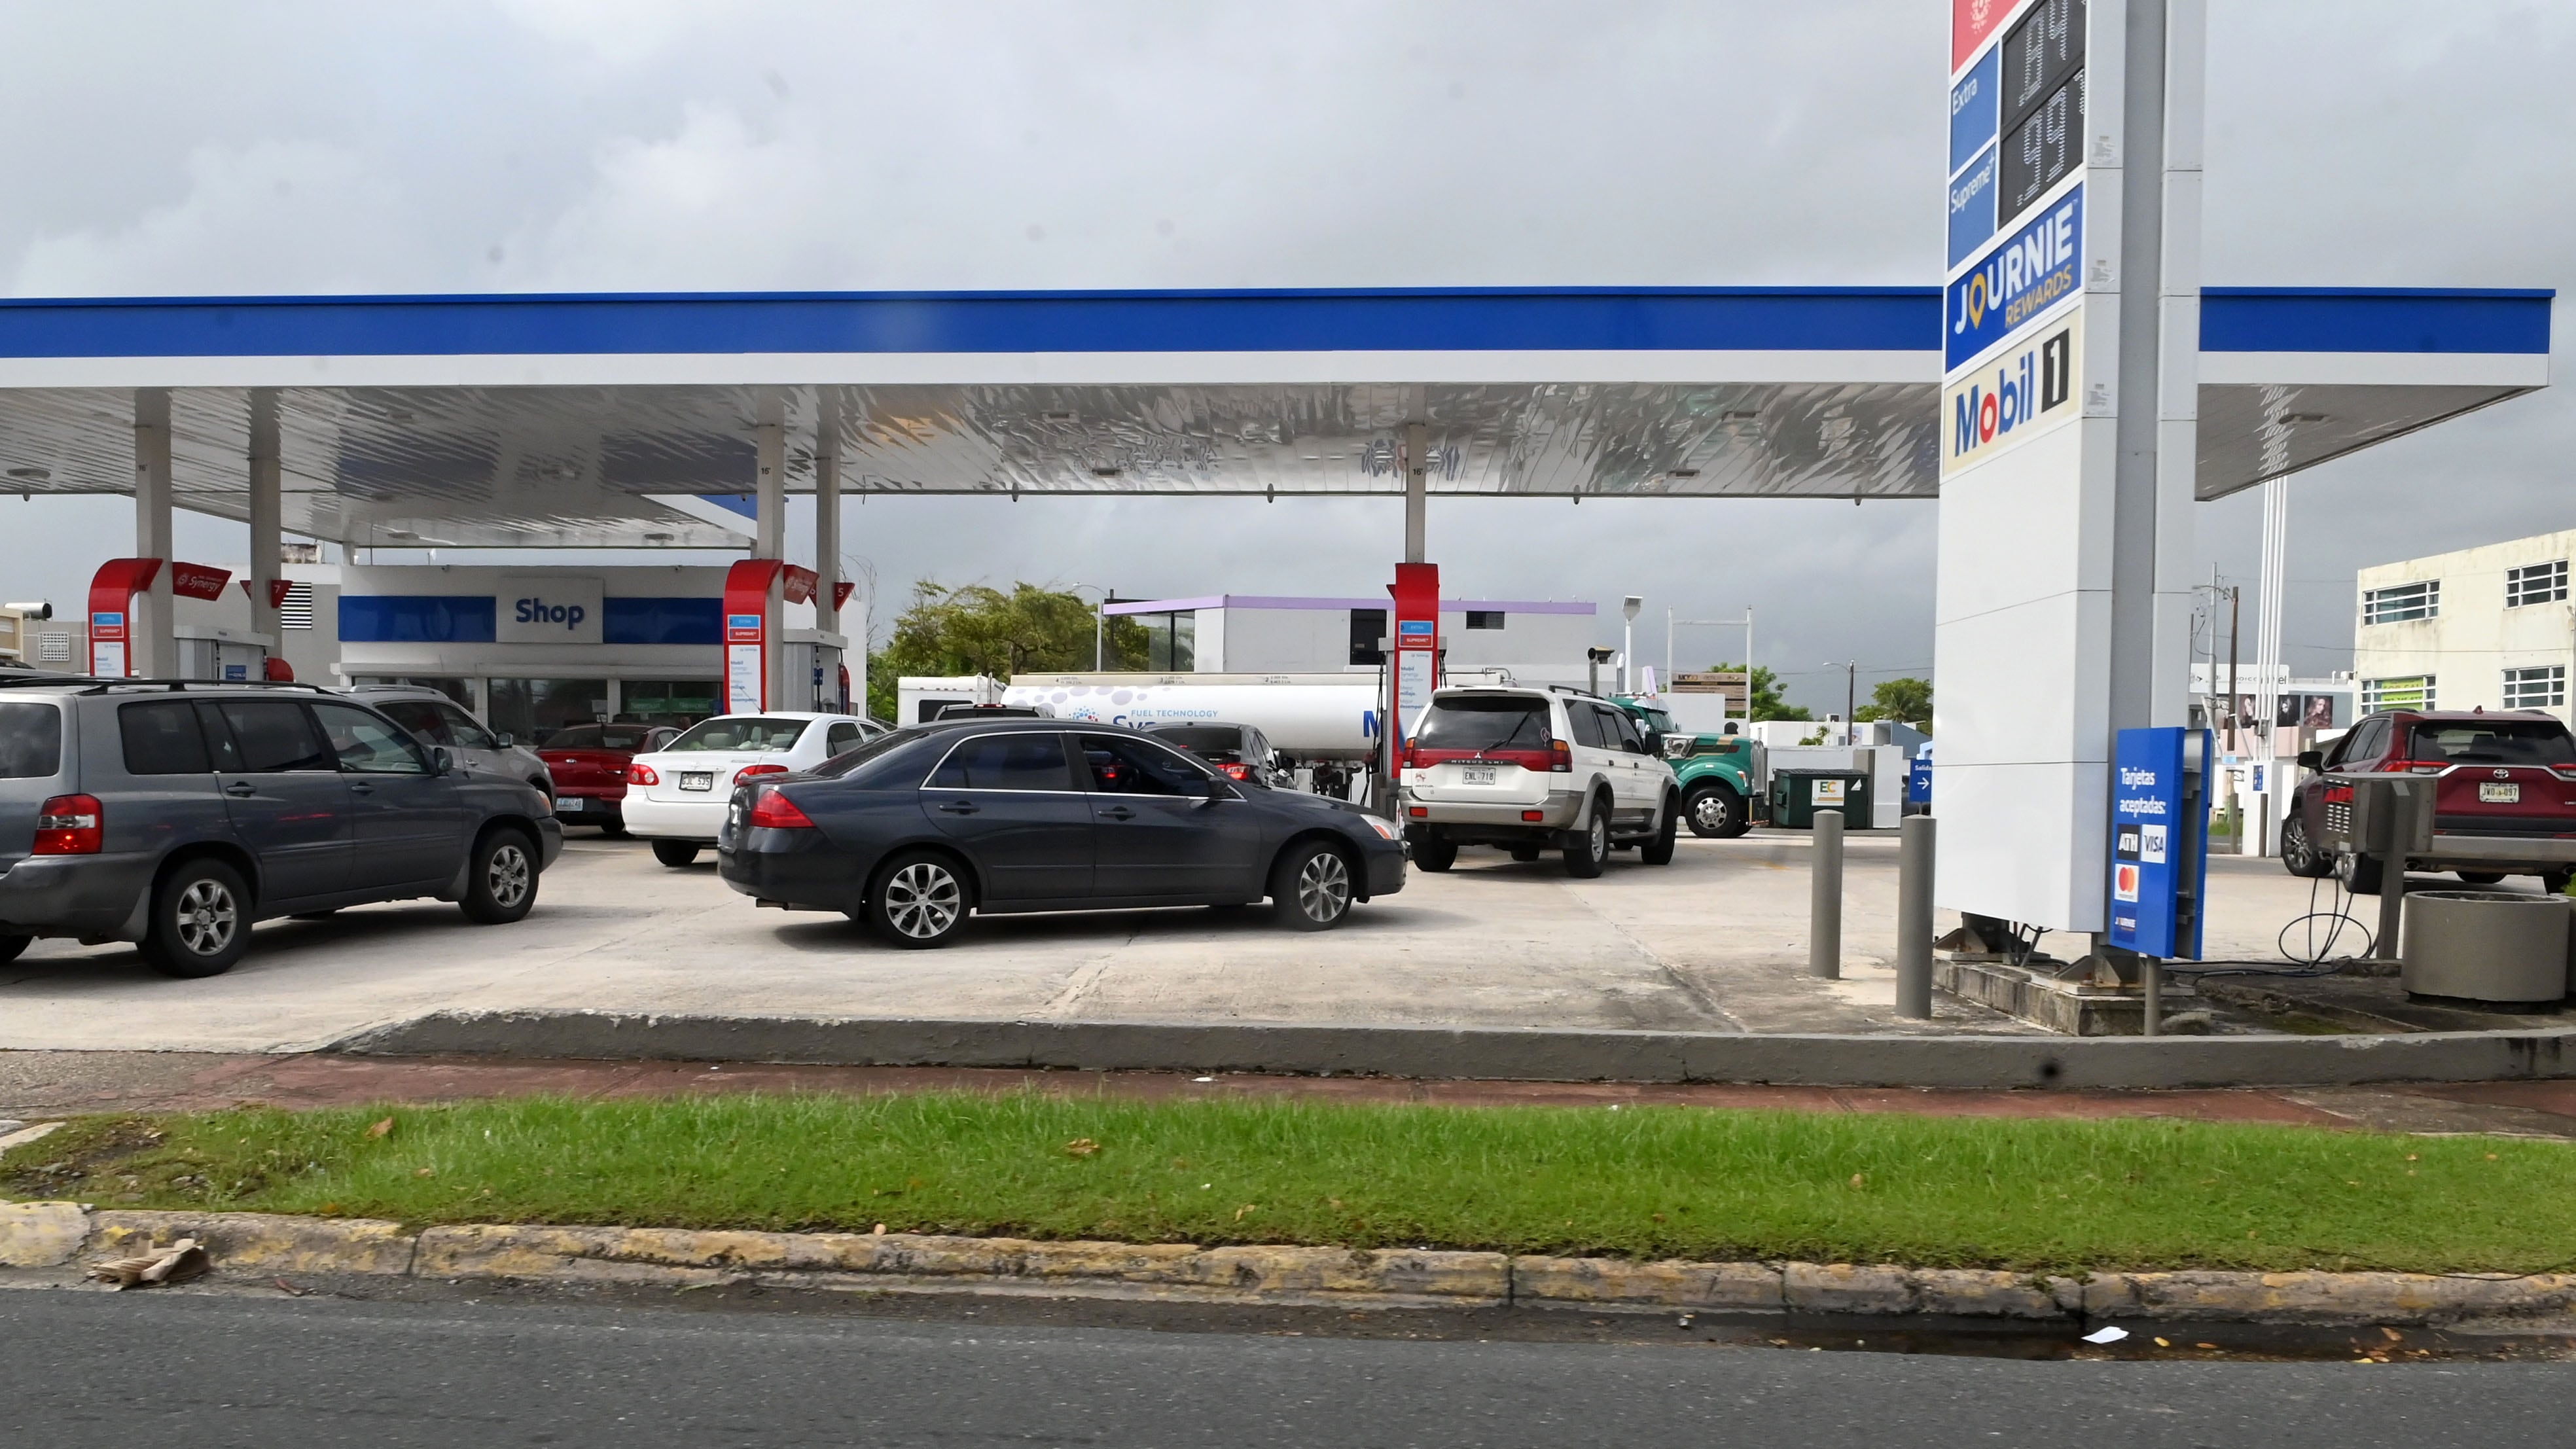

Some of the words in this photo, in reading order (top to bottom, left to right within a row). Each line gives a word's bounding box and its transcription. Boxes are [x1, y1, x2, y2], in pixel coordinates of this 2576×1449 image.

[1952, 78, 1978, 116] Extra
[2005, 264, 2072, 329] REWARDS
[1955, 350, 2033, 457] Mobil
[188, 577, 221, 592] Synergy
[838, 588, 844, 597] 5
[516, 598, 584, 630] Shop
[1465, 772, 1476, 781] ENL
[1482, 772, 1494, 781] 718
[1820, 781, 1837, 793] EC
[2120, 766, 2155, 790] Tarjetas
[2503, 787, 2517, 796] 097
[2120, 795, 2166, 817] aceptadas:
[2118, 832, 2139, 852] ATH
[2144, 834, 2165, 853] VISA
